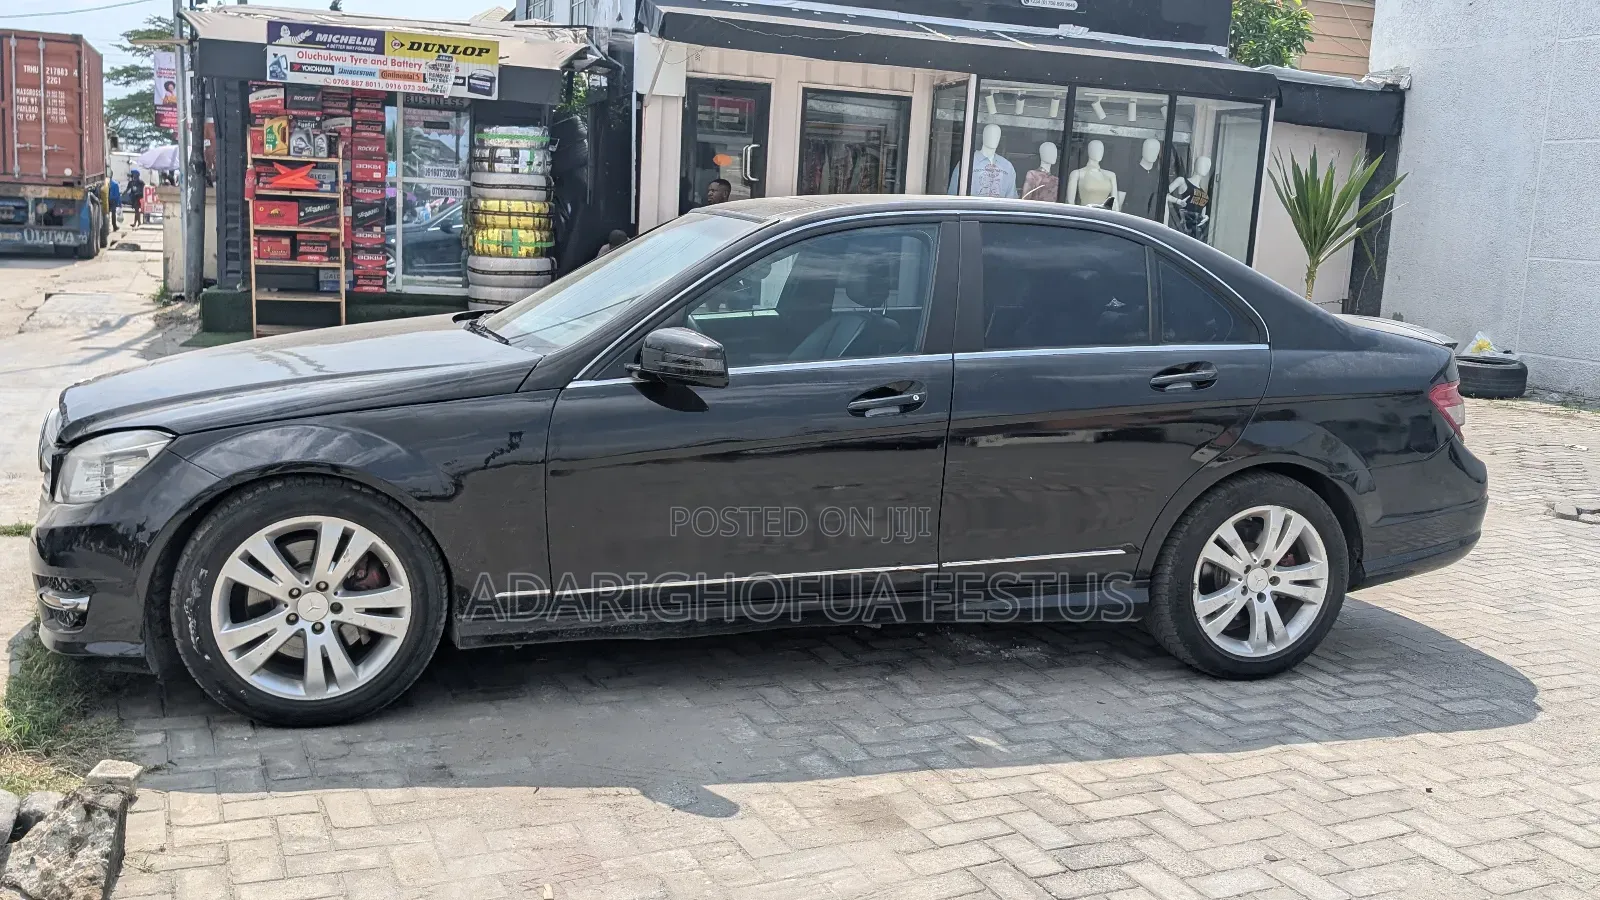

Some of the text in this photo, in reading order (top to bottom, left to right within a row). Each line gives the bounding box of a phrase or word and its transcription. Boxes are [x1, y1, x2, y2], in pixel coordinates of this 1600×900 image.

[315, 33, 378, 47] MICHELIN
[407, 41, 491, 57] DUNLOP
[296, 50, 422, 70] Oluchukwu Tyre and Battery
[301, 65, 333, 74] YOKOHAMA
[380, 69, 415, 79] Continental
[332, 77, 350, 85] 0708
[385, 82, 402, 90] 0916
[405, 95, 465, 107] BUSINESS
